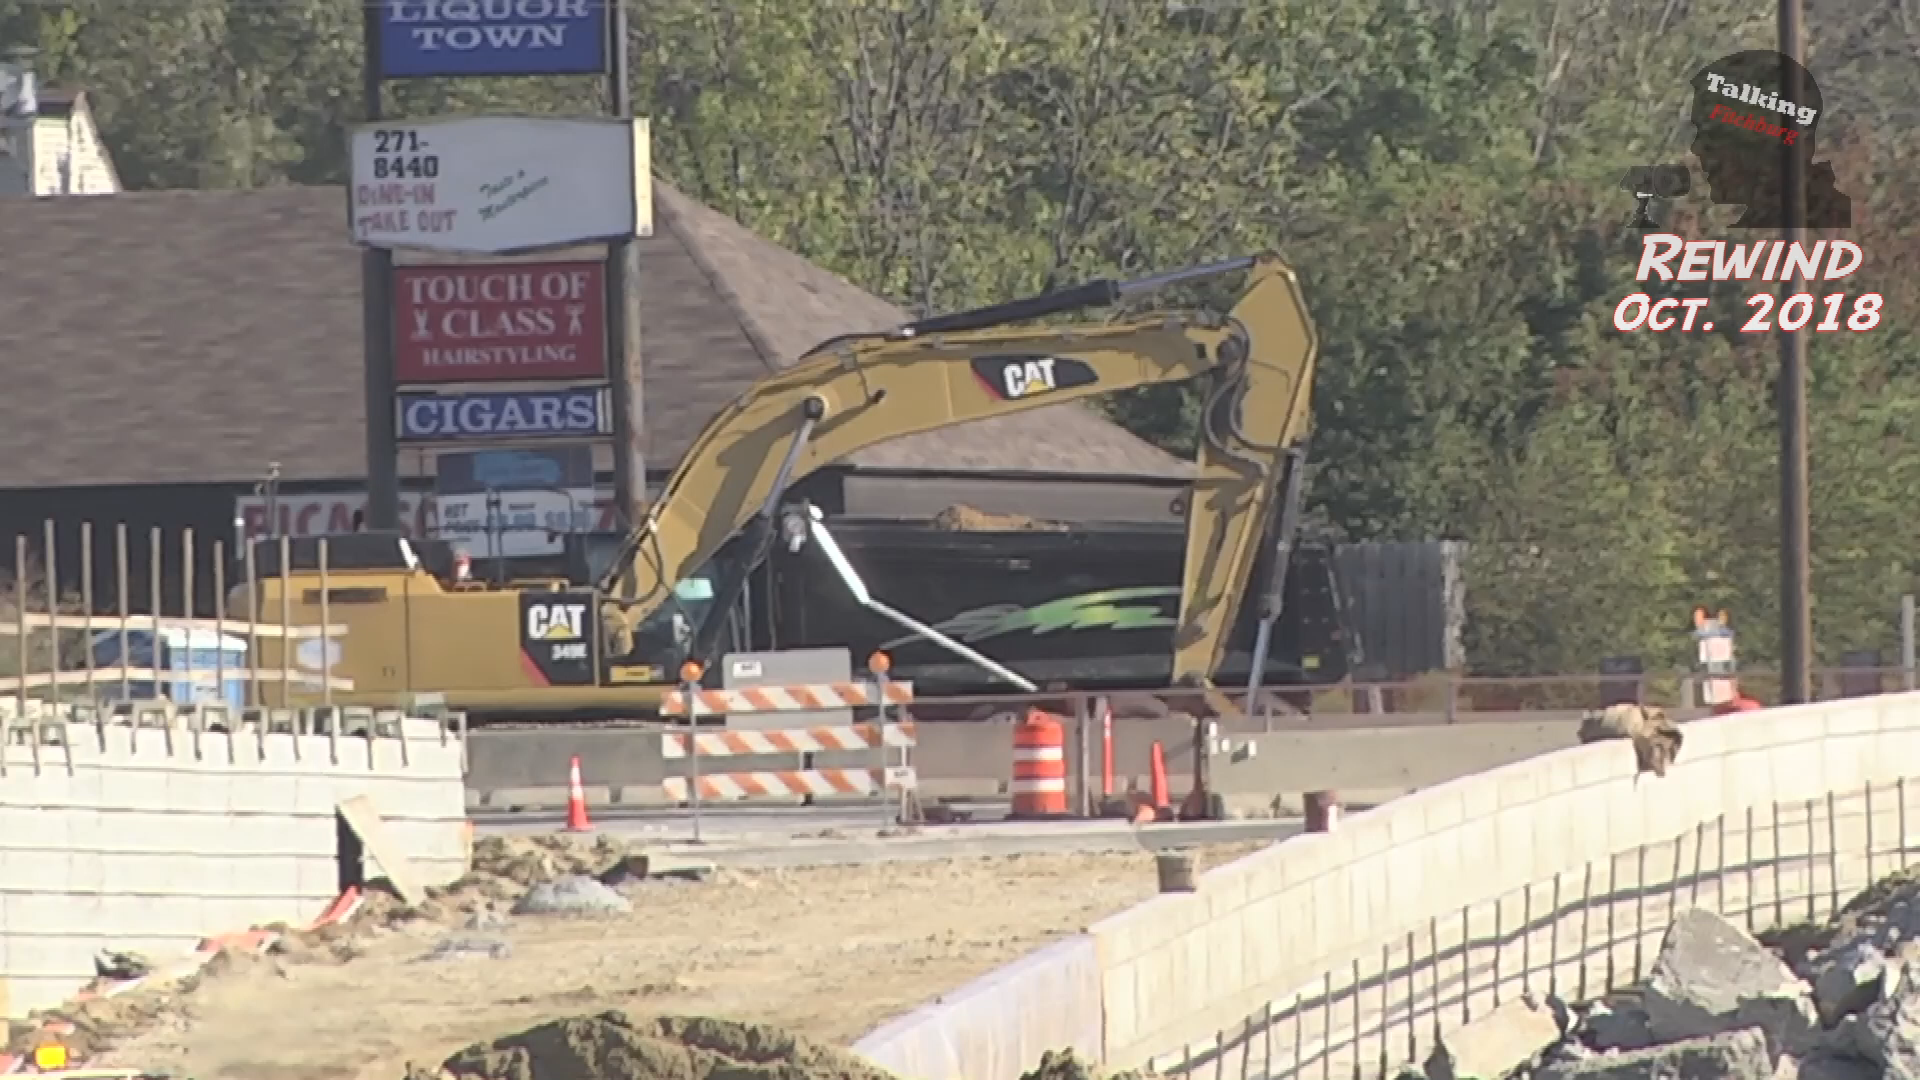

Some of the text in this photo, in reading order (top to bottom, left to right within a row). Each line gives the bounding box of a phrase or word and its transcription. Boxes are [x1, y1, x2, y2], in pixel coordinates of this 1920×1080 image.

[389, 0, 589, 22] LIQUOR
[412, 24, 567, 50] TOWN
[374, 130, 429, 153] 271-
[374, 155, 439, 178] 8440
[357, 208, 458, 237] TAKE OUT
[405, 271, 591, 304] TOUCH OF
[441, 307, 556, 338] CLASS
[422, 344, 577, 366] HAIRSTYLING
[1003, 358, 1056, 397] CAT
[406, 395, 596, 434] CIGARS
[528, 603, 586, 639] CAT
